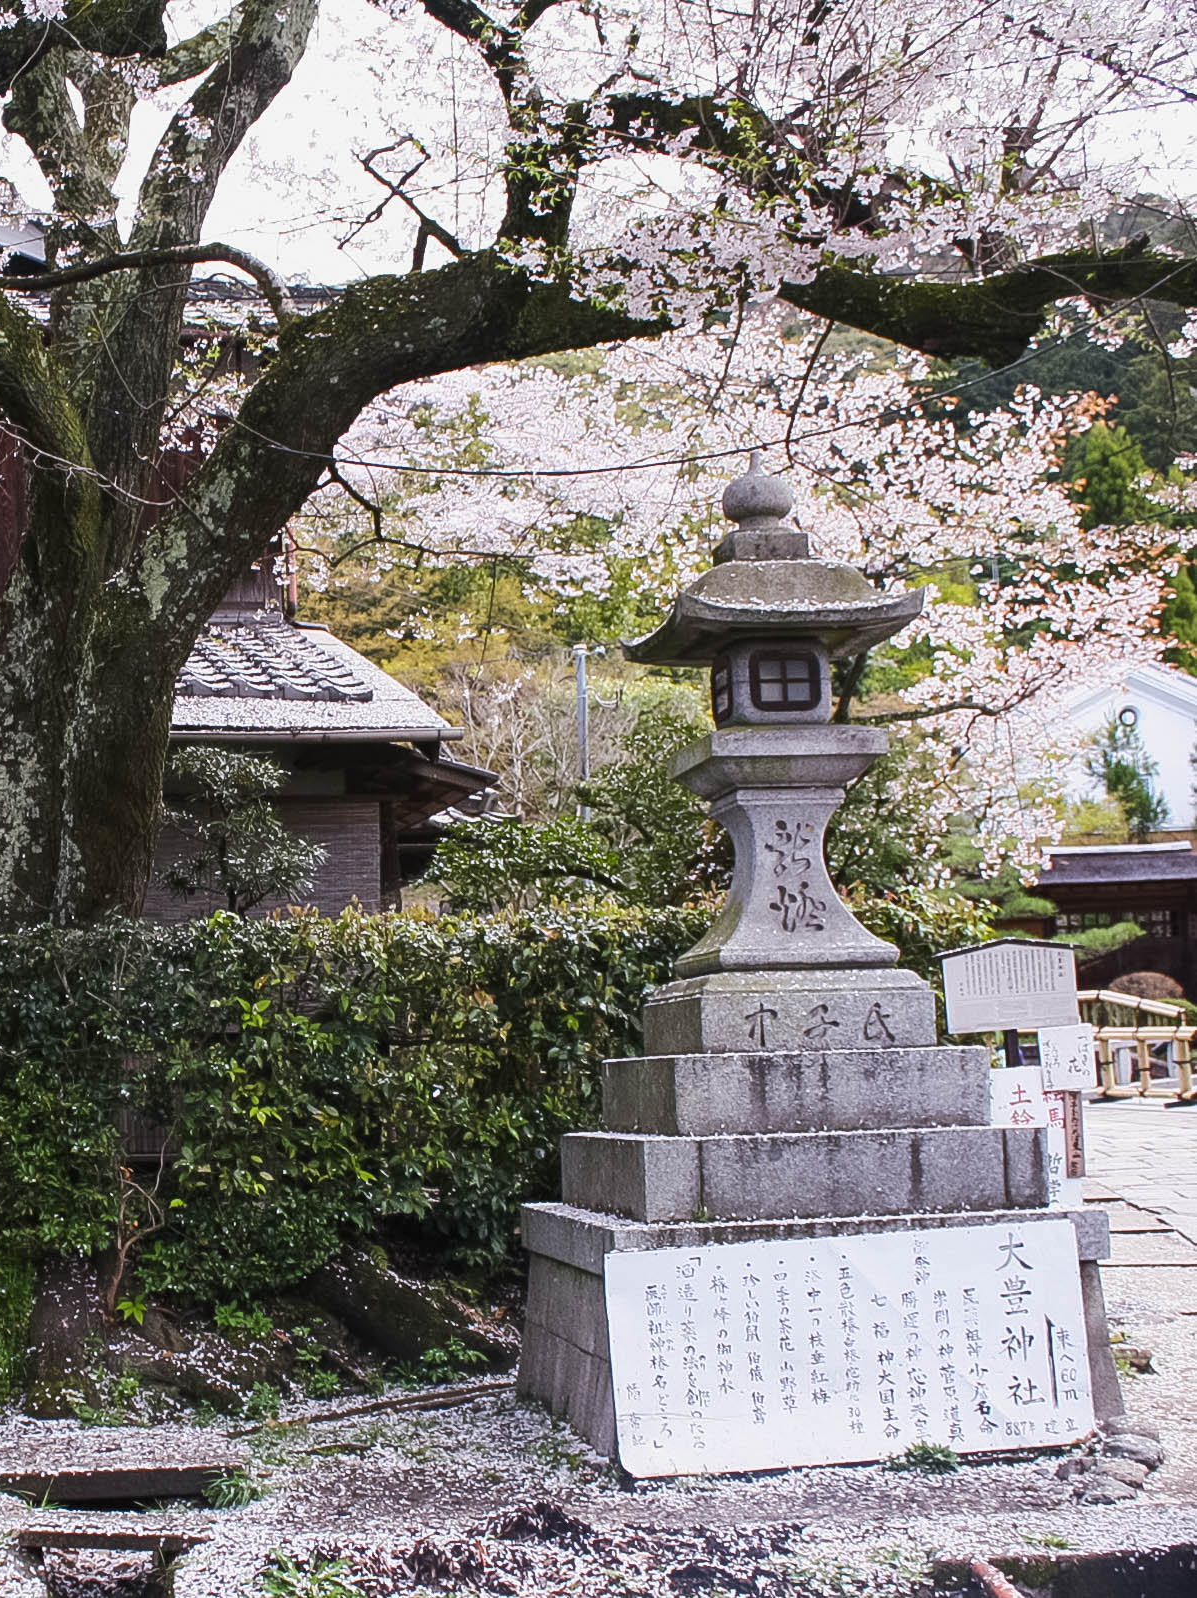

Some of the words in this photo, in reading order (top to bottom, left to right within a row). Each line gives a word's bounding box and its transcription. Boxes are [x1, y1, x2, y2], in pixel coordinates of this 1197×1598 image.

[1067, 1056, 1083, 1074] 花
[1008, 1082, 1036, 1125] 土鈴
[995, 1230, 1046, 1406] 大豊神社
